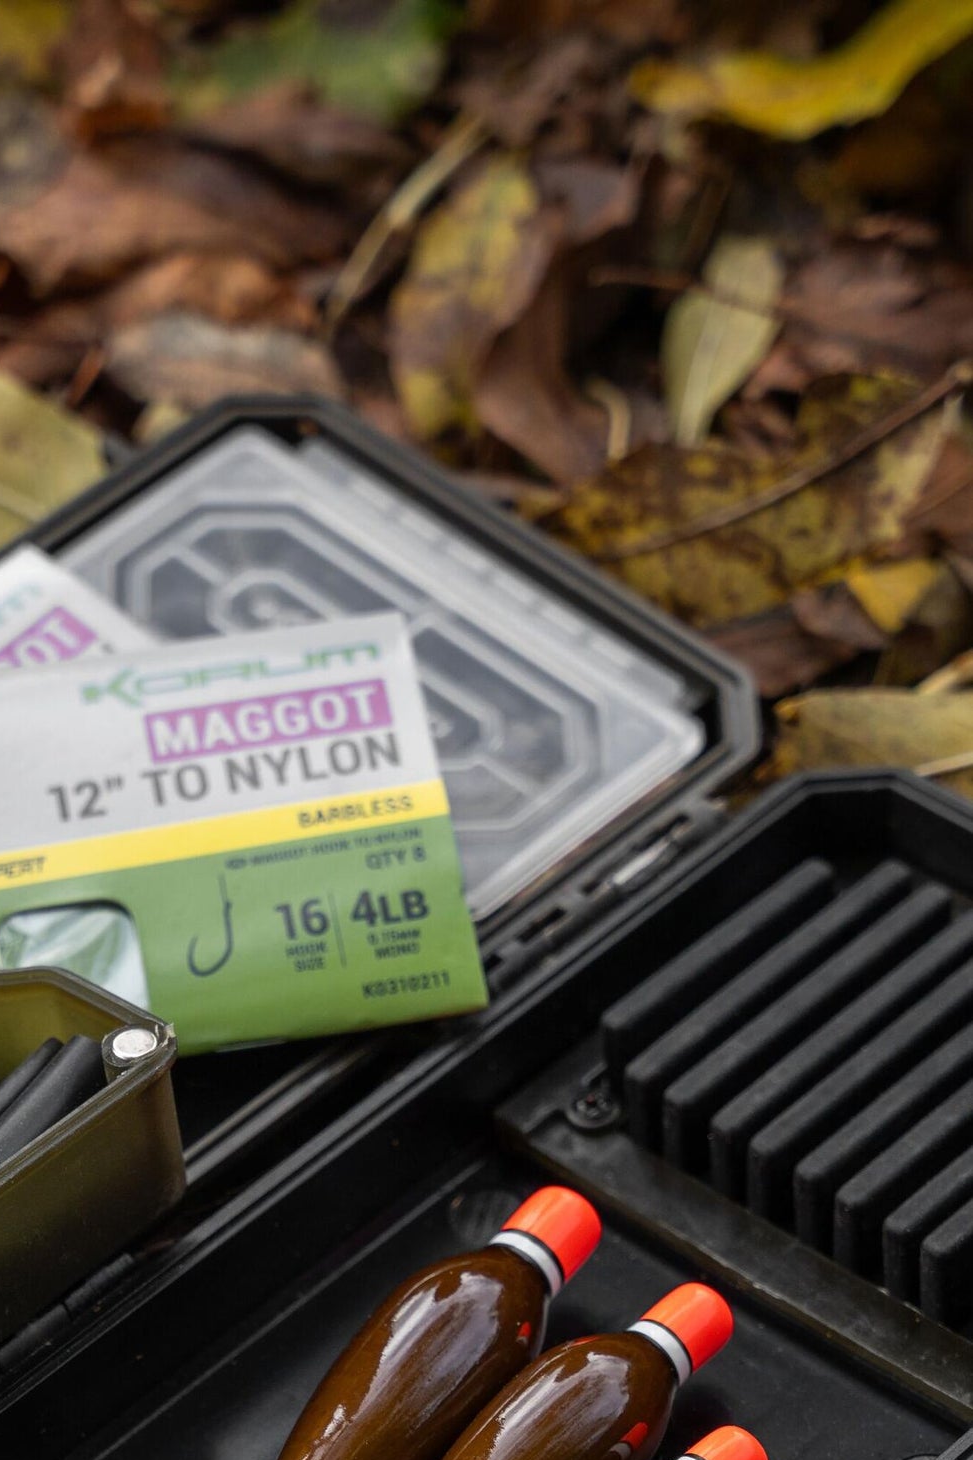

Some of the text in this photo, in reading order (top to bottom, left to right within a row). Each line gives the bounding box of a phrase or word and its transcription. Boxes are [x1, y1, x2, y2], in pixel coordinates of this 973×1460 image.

[82, 641, 382, 709] KORUM
[149, 686, 378, 759] MAGGOT
[48, 732, 402, 823] 12" TO NYLON
[298, 795, 413, 828] BARBLESS
[365, 849, 407, 870] QTY
[275, 897, 330, 941] 16
[350, 889, 430, 928] 4LB
